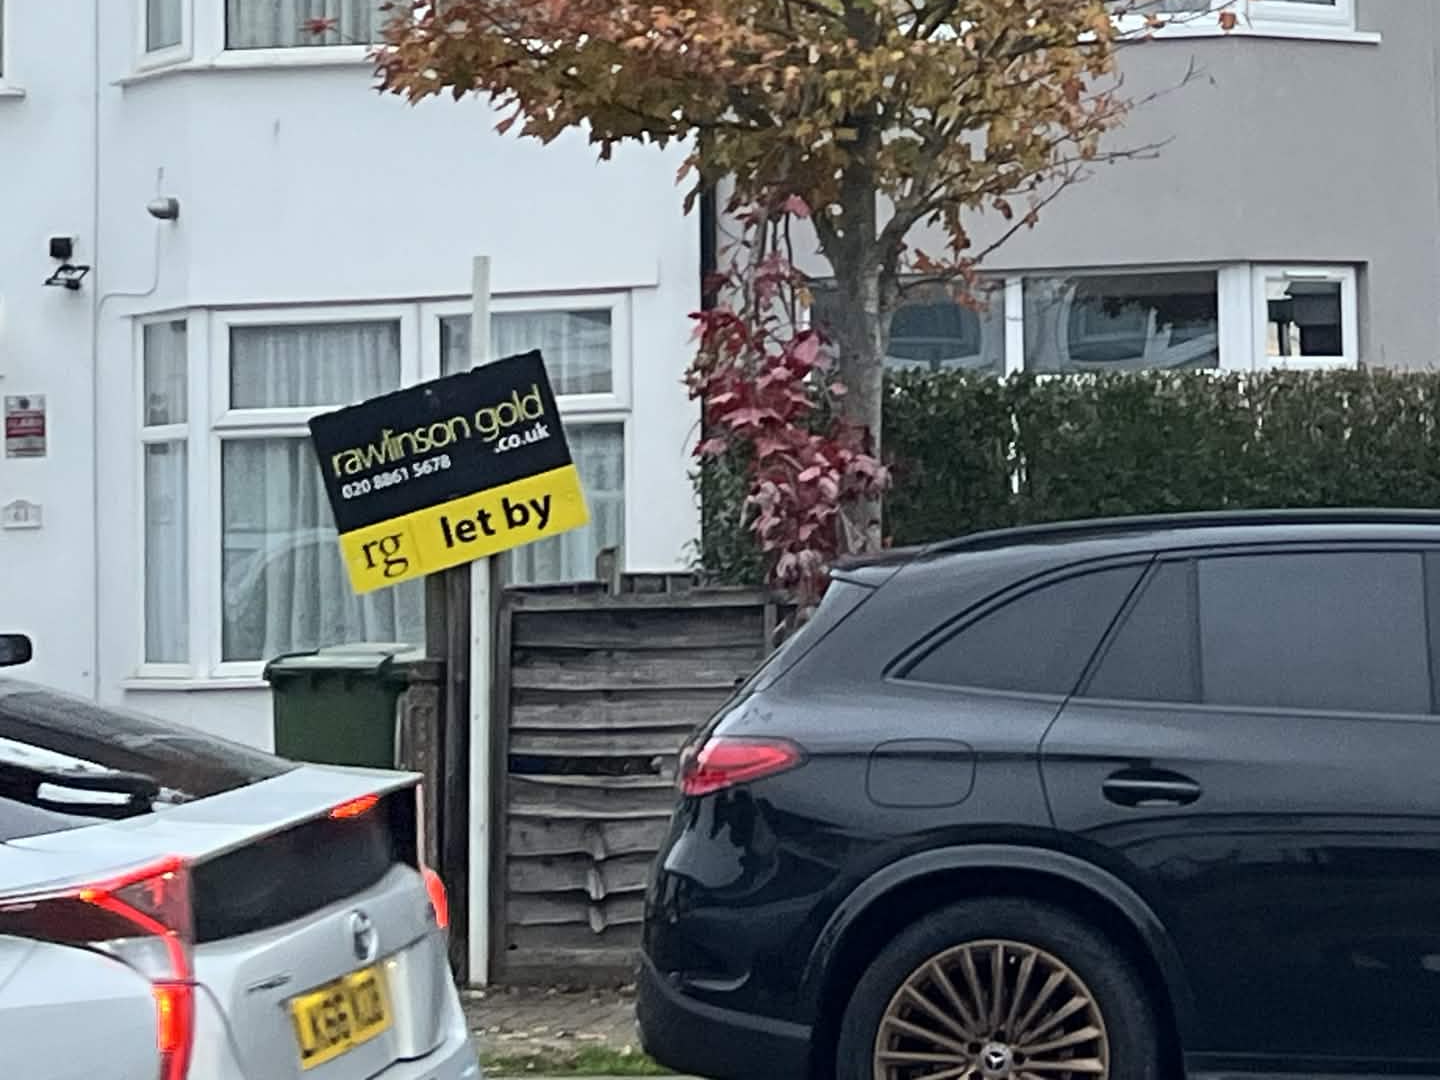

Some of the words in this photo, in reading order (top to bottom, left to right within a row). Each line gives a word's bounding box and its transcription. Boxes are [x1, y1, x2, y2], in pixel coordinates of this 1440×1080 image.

[331, 416, 471, 478] rawlinson
[474, 384, 545, 443] gold
[493, 422, 551, 453] .co.uk
[341, 478, 371, 500] 020
[372, 467, 410, 490] 8861
[412, 453, 451, 478] 5678
[361, 531, 409, 578] rg
[440, 508, 496, 549] let
[501, 493, 552, 531] by
